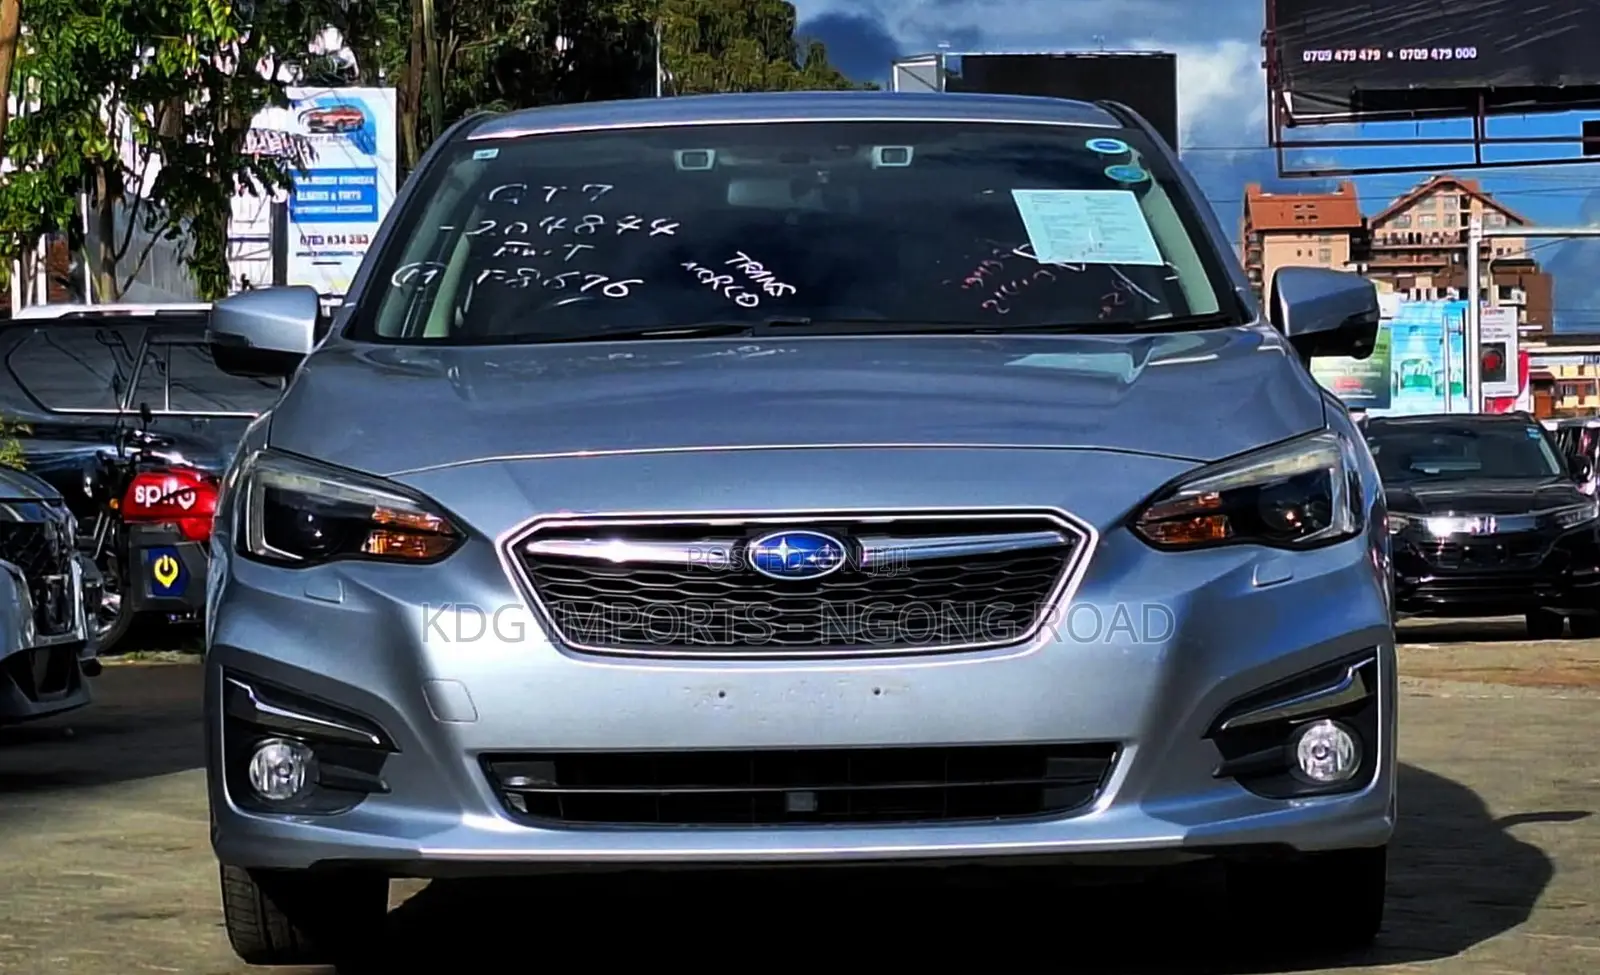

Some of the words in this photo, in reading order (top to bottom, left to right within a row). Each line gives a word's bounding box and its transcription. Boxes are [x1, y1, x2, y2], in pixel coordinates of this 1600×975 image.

[1303, 50, 1332, 62] 0709
[1334, 50, 1356, 61] 479
[1359, 49, 1381, 61] 479
[1400, 49, 1428, 60] 0709
[1431, 48, 1452, 60] 479
[1455, 47, 1477, 59] 000
